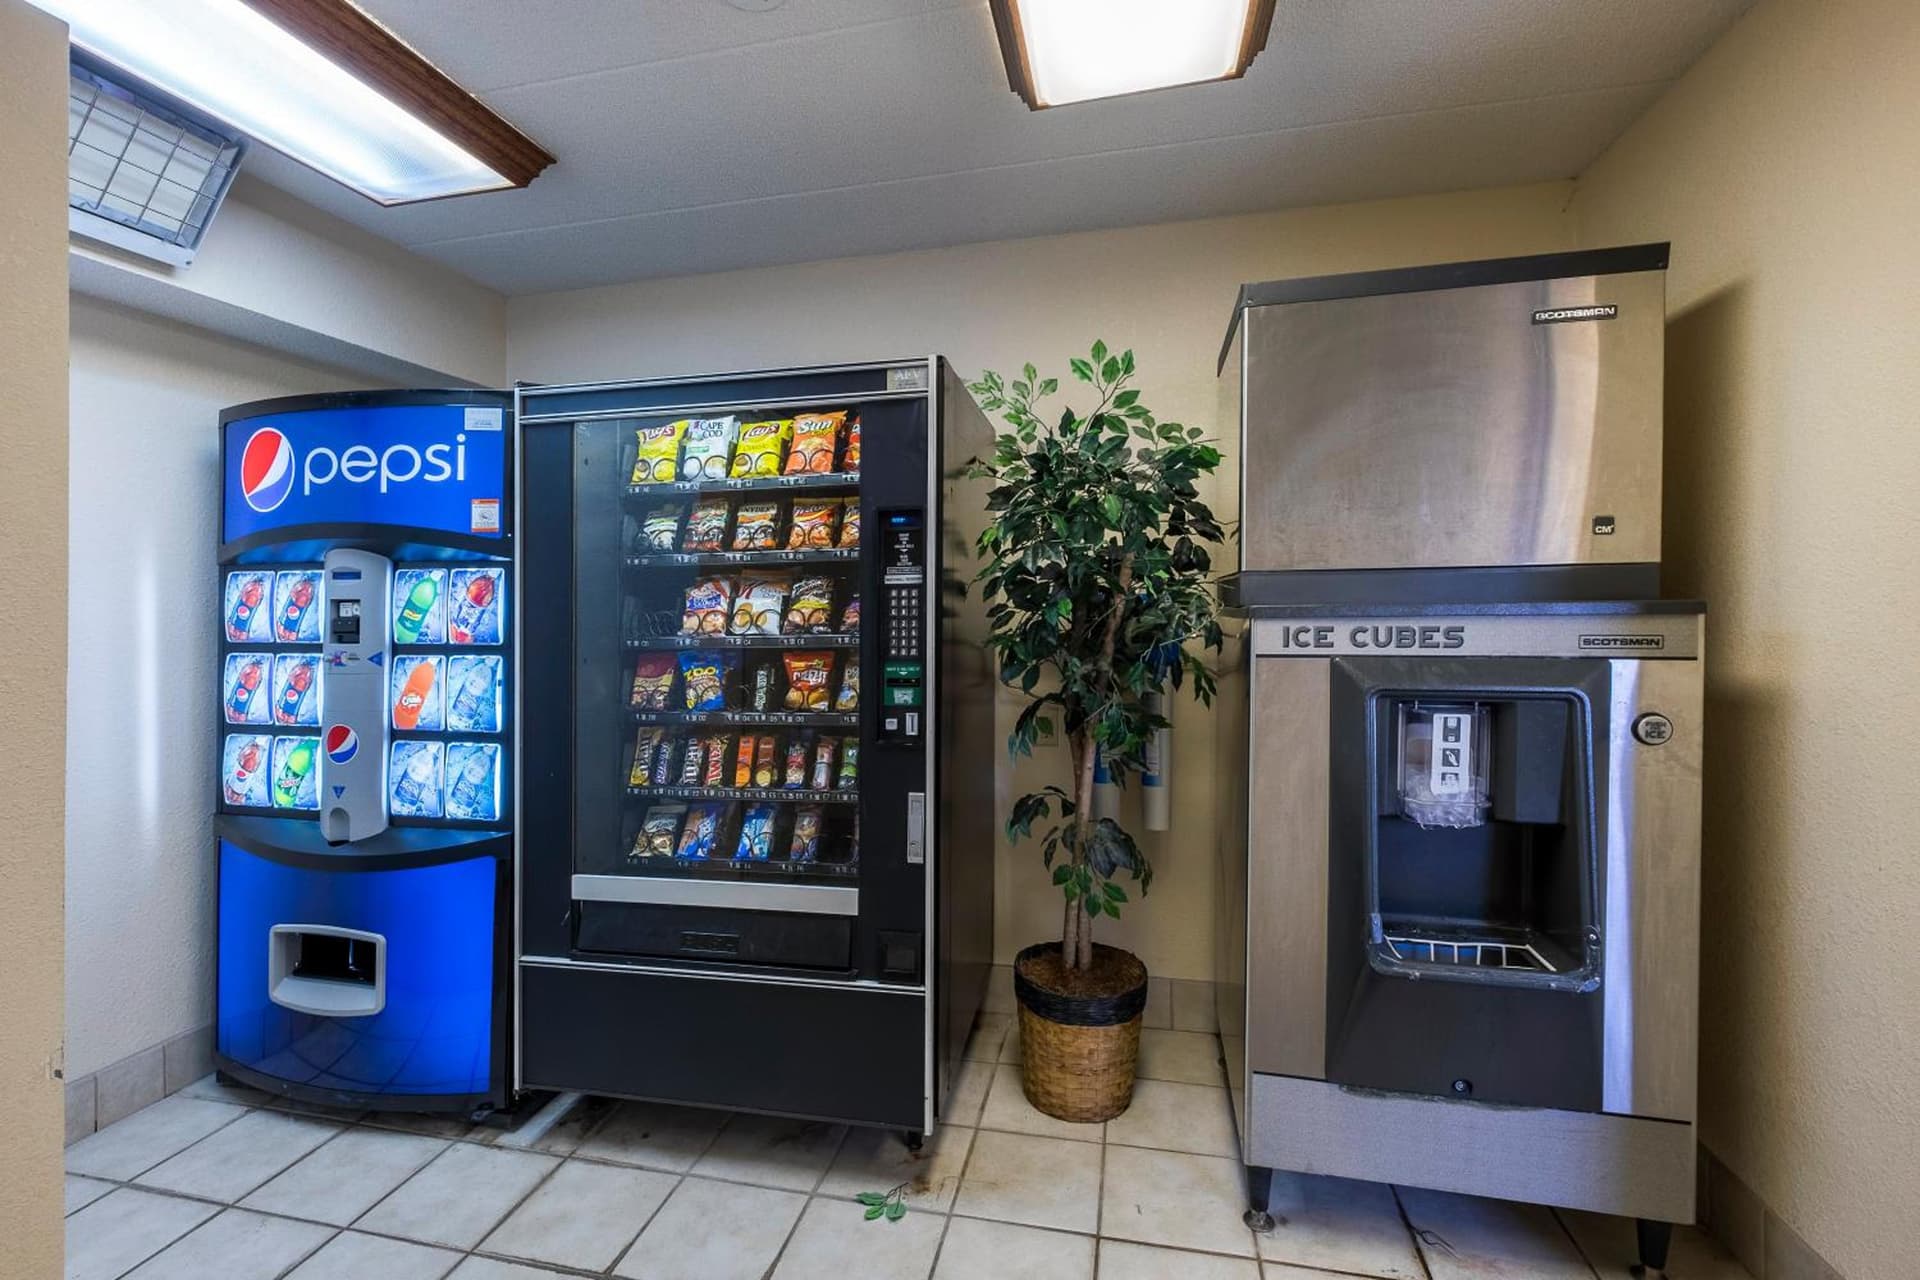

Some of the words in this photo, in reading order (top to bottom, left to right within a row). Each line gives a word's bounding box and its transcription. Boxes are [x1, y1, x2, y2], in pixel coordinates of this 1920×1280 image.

[1535, 306, 1615, 320] SCOTSMAN
[699, 421, 724, 431] CAPE
[797, 419, 833, 434] Sun
[702, 430, 723, 439] COD
[304, 433, 466, 495] pepsi
[1282, 626, 1334, 649] ICE
[1349, 626, 1465, 648] CUBES
[1582, 637, 1661, 647] SCOTSMAN
[1645, 730, 1666, 739] ICE
